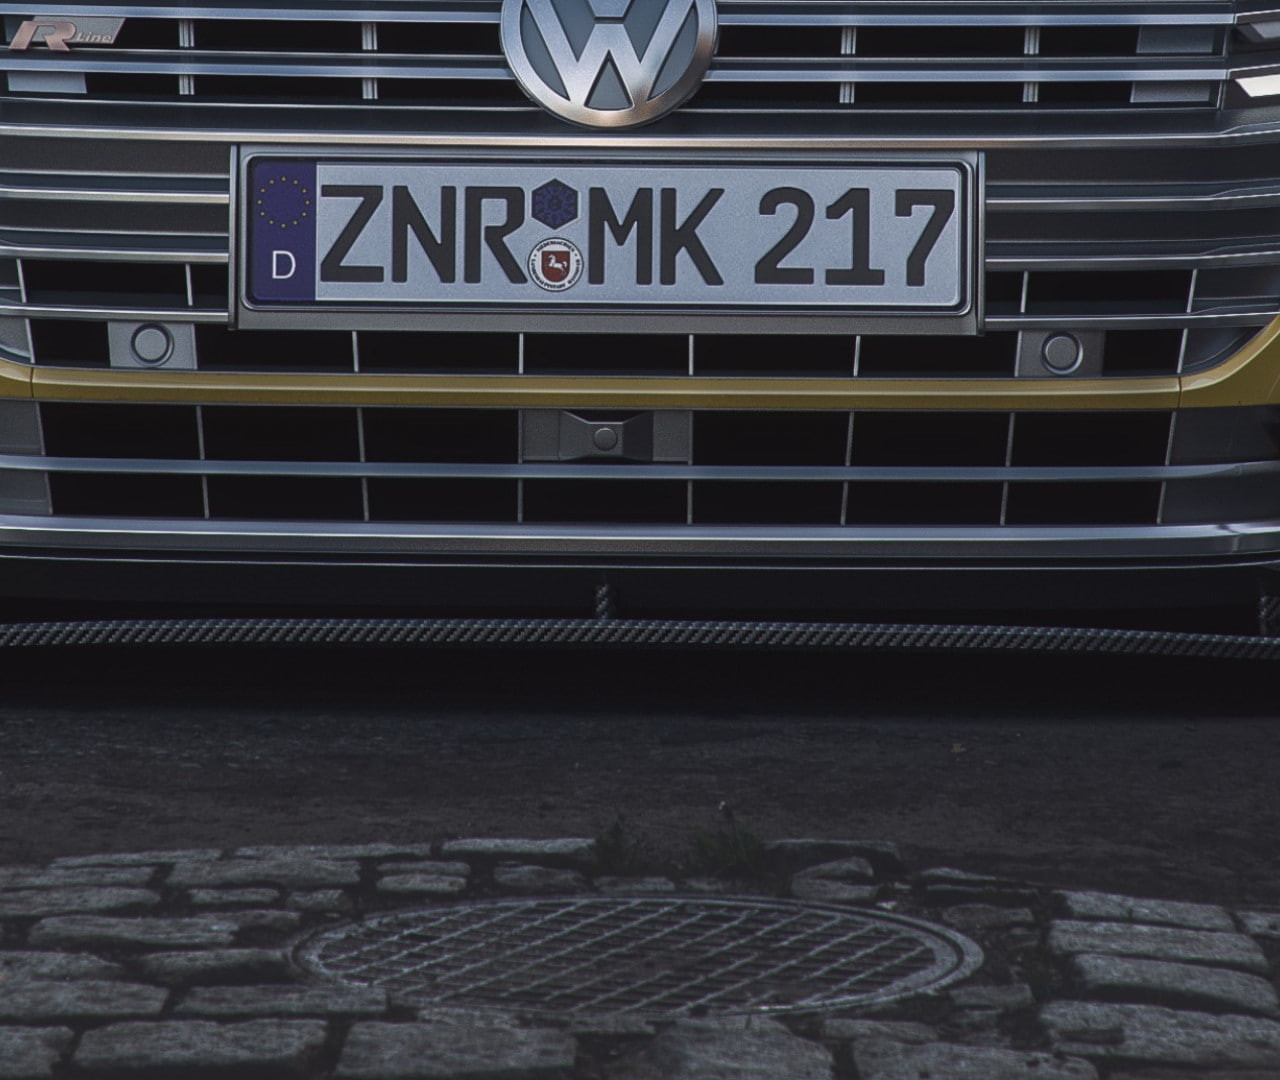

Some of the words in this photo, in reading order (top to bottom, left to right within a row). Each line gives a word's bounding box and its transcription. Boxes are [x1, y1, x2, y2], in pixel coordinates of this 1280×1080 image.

[272, 250, 296, 279] D
[320, 184, 528, 284] ZNR
[587, 186, 725, 286] MK
[754, 186, 955, 287] 217
